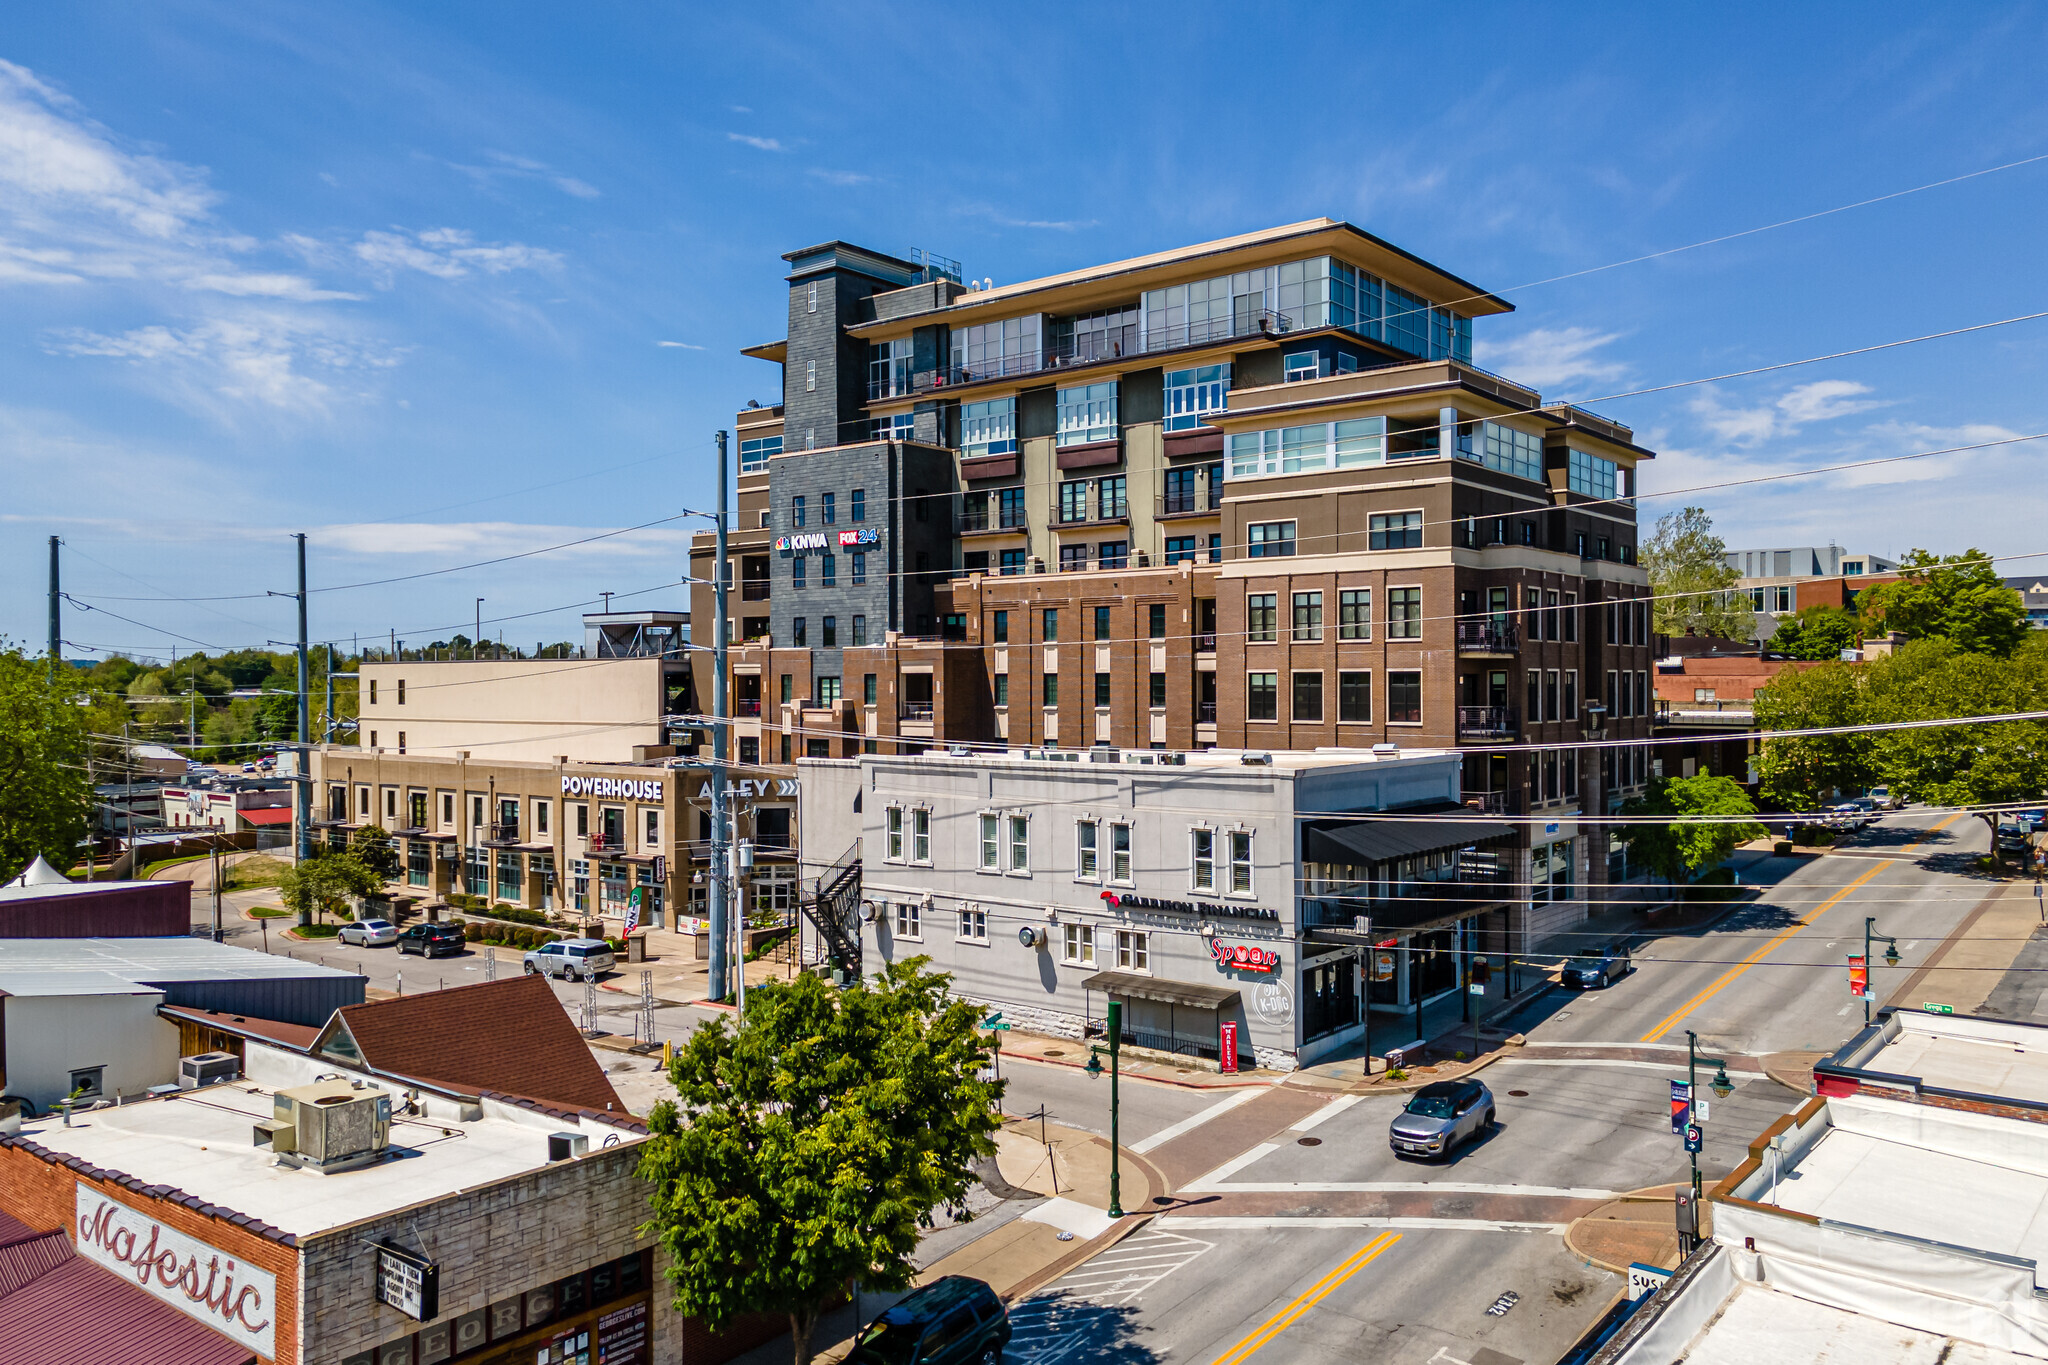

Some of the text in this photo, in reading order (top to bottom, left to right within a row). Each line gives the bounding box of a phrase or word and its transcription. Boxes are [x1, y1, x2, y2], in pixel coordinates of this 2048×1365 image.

[791, 533, 828, 549] KNWA
[839, 528, 877, 545] FOX 24
[561, 776, 663, 800] POWERHOUSE
[700, 778, 770, 798] ALEY
[1121, 893, 1279, 921] GARRISON FINANCIAL
[1211, 938, 1278, 966] Spoon
[1689, 1131, 1696, 1139] P
[80, 1200, 270, 1334] Majestic
[1632, 1274, 1664, 1289] SUS
[1488, 1296, 1518, 1316] 7342
